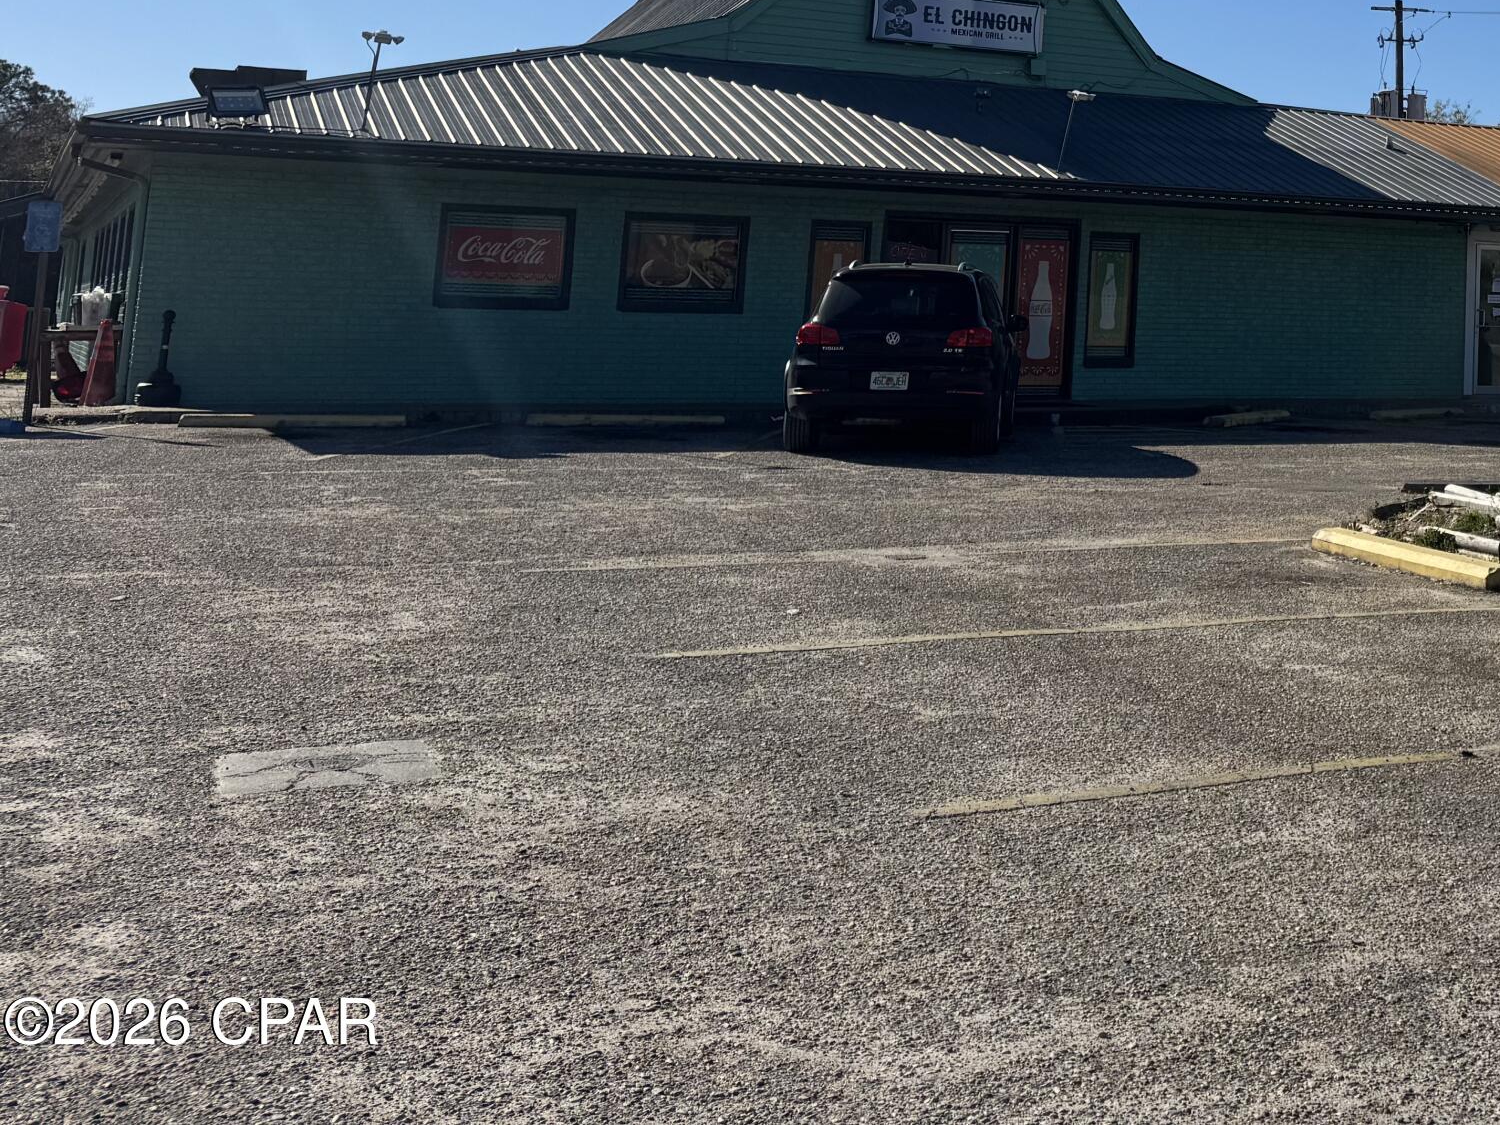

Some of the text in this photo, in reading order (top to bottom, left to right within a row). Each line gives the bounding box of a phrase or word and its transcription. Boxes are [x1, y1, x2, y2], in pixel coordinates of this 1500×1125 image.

[923, 5, 1033, 34] EL CHINGON
[950, 28, 1004, 41] MEXICAN GRILL
